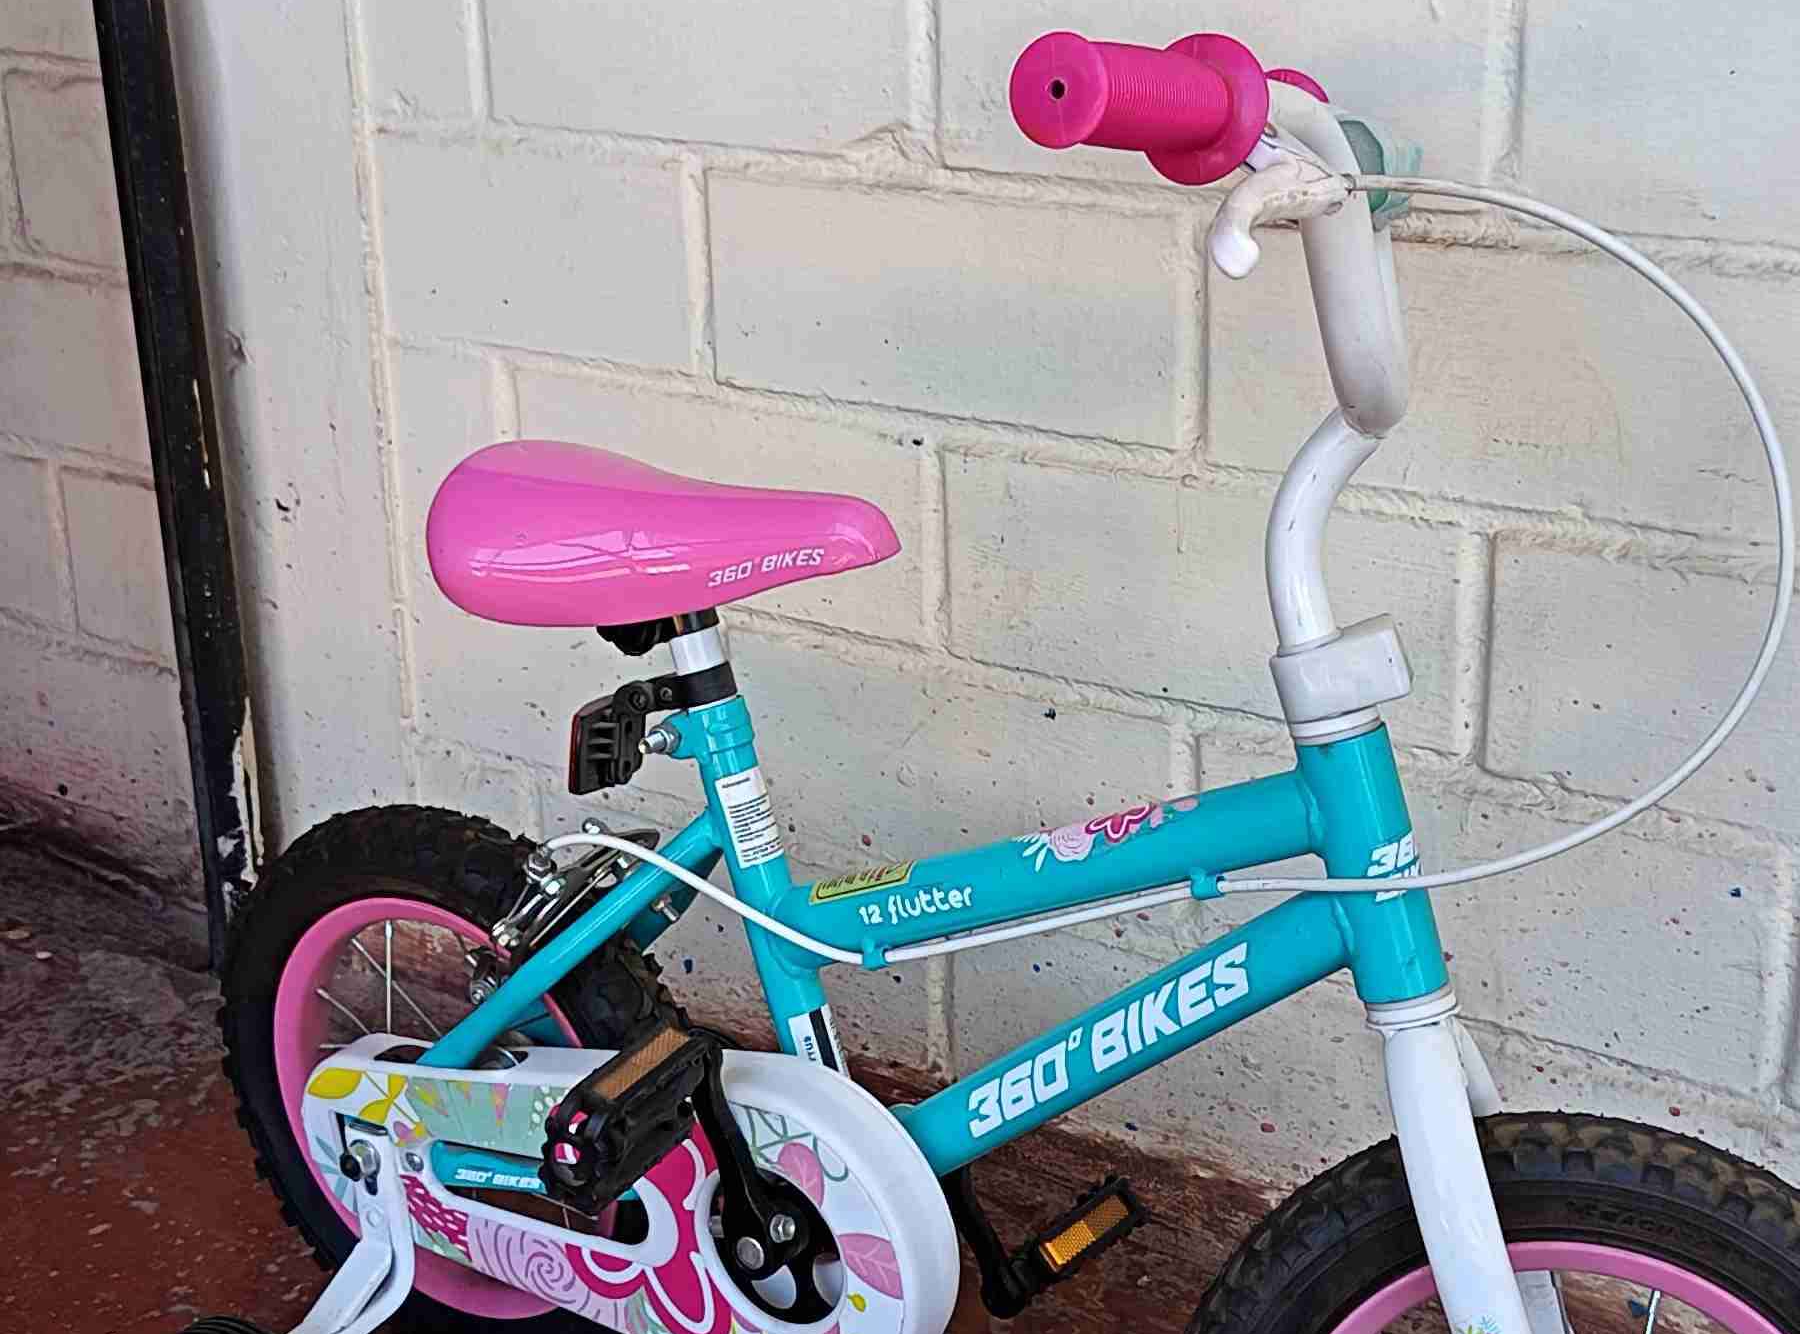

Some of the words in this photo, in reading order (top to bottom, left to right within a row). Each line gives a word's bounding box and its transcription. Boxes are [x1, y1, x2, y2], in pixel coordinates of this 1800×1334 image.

[761, 548, 825, 572] BIKES
[1366, 833, 1418, 877] 36
[859, 904, 883, 925] 12
[888, 886, 972, 925] flutter
[1091, 942, 1249, 1074] BIKES
